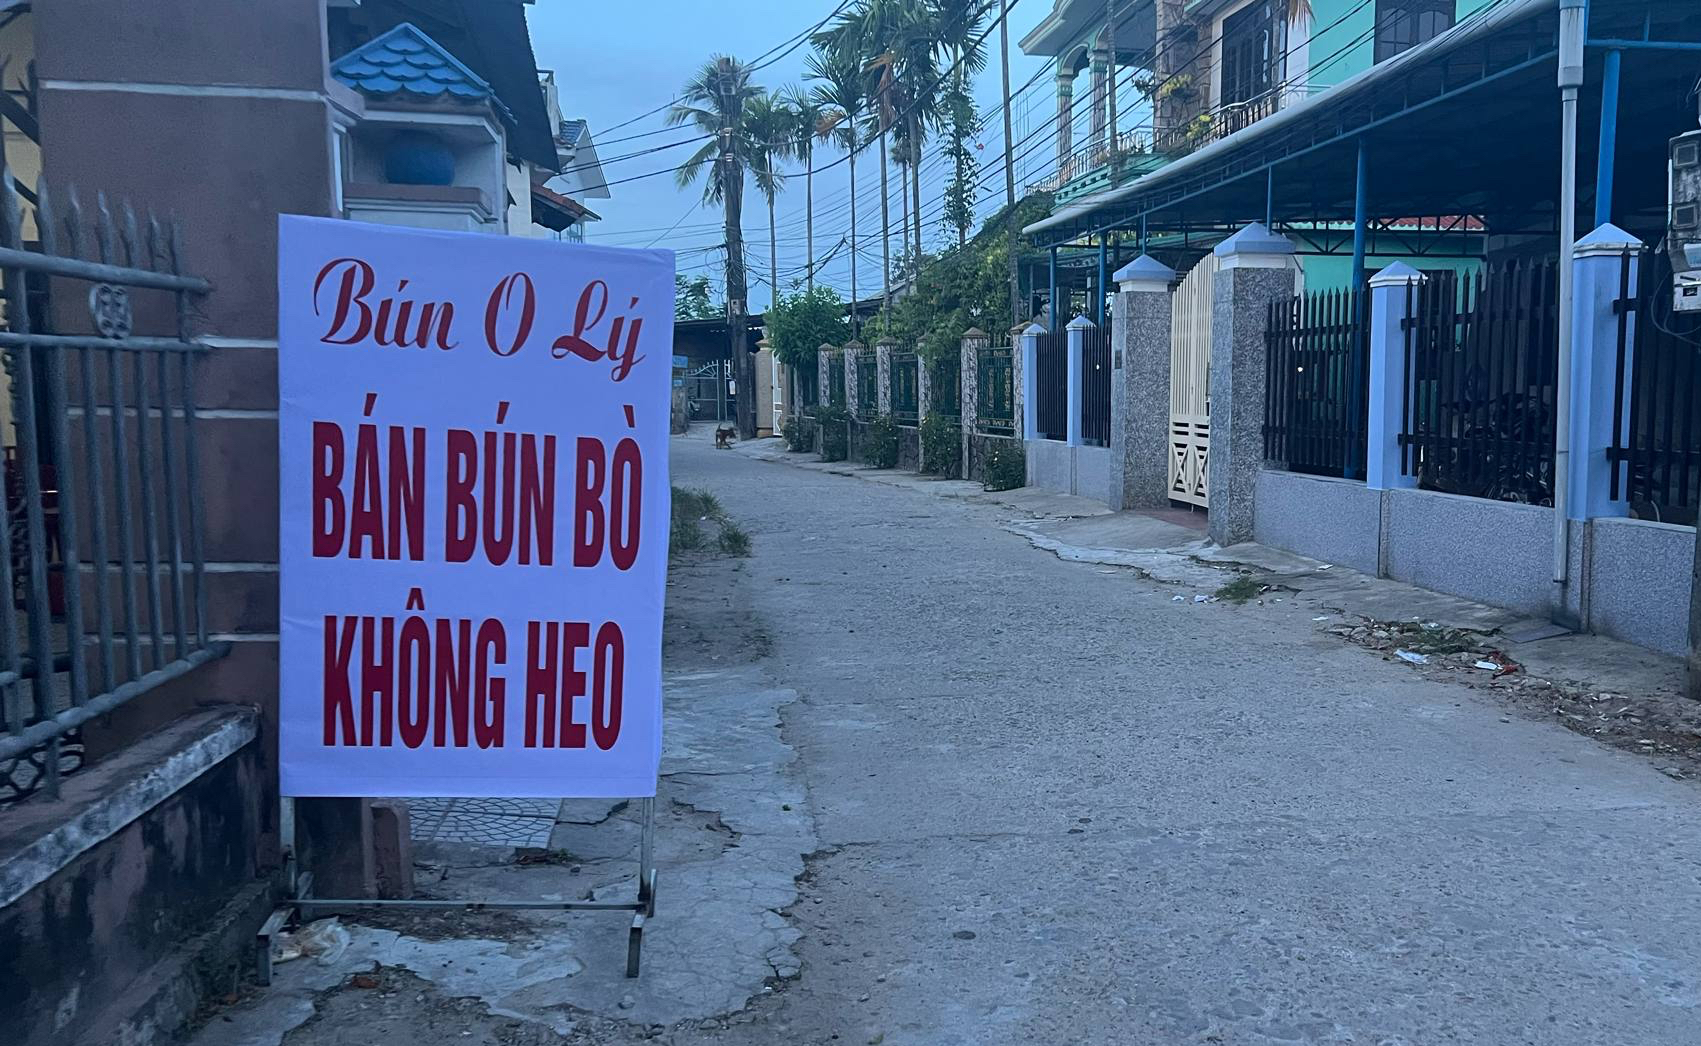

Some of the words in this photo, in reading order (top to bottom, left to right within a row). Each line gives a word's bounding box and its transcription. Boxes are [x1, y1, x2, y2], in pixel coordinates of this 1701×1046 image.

[313, 257, 460, 351] Bún
[484, 271, 537, 357] O
[551, 279, 646, 382] Lý
[312, 393, 427, 562] BÁN
[445, 401, 557, 567] BÚN
[573, 404, 643, 571] BÒ
[323, 587, 507, 750] KHÔNG
[524, 620, 626, 751] HEO
